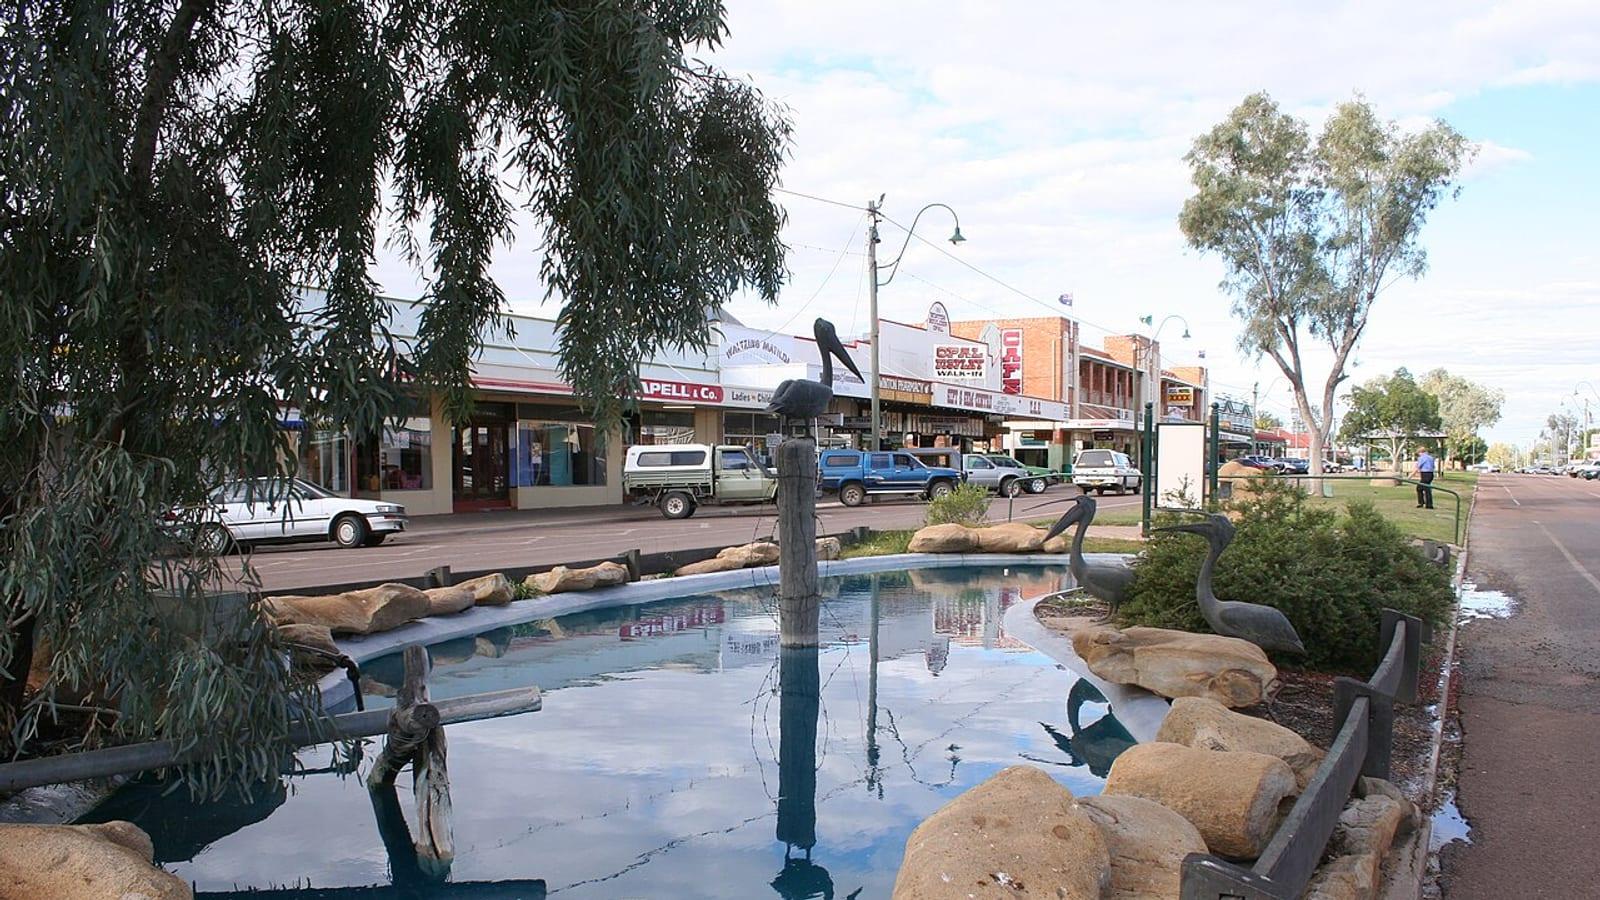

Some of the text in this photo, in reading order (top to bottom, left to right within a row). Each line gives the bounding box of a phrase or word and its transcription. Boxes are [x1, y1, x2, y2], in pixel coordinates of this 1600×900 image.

[726, 339, 760, 359] WALTZING
[936, 346, 983, 358] OPAL
[1003, 331, 1020, 394] CAFE
[700, 387, 718, 400] Co.
[731, 391, 751, 401] Ladies
